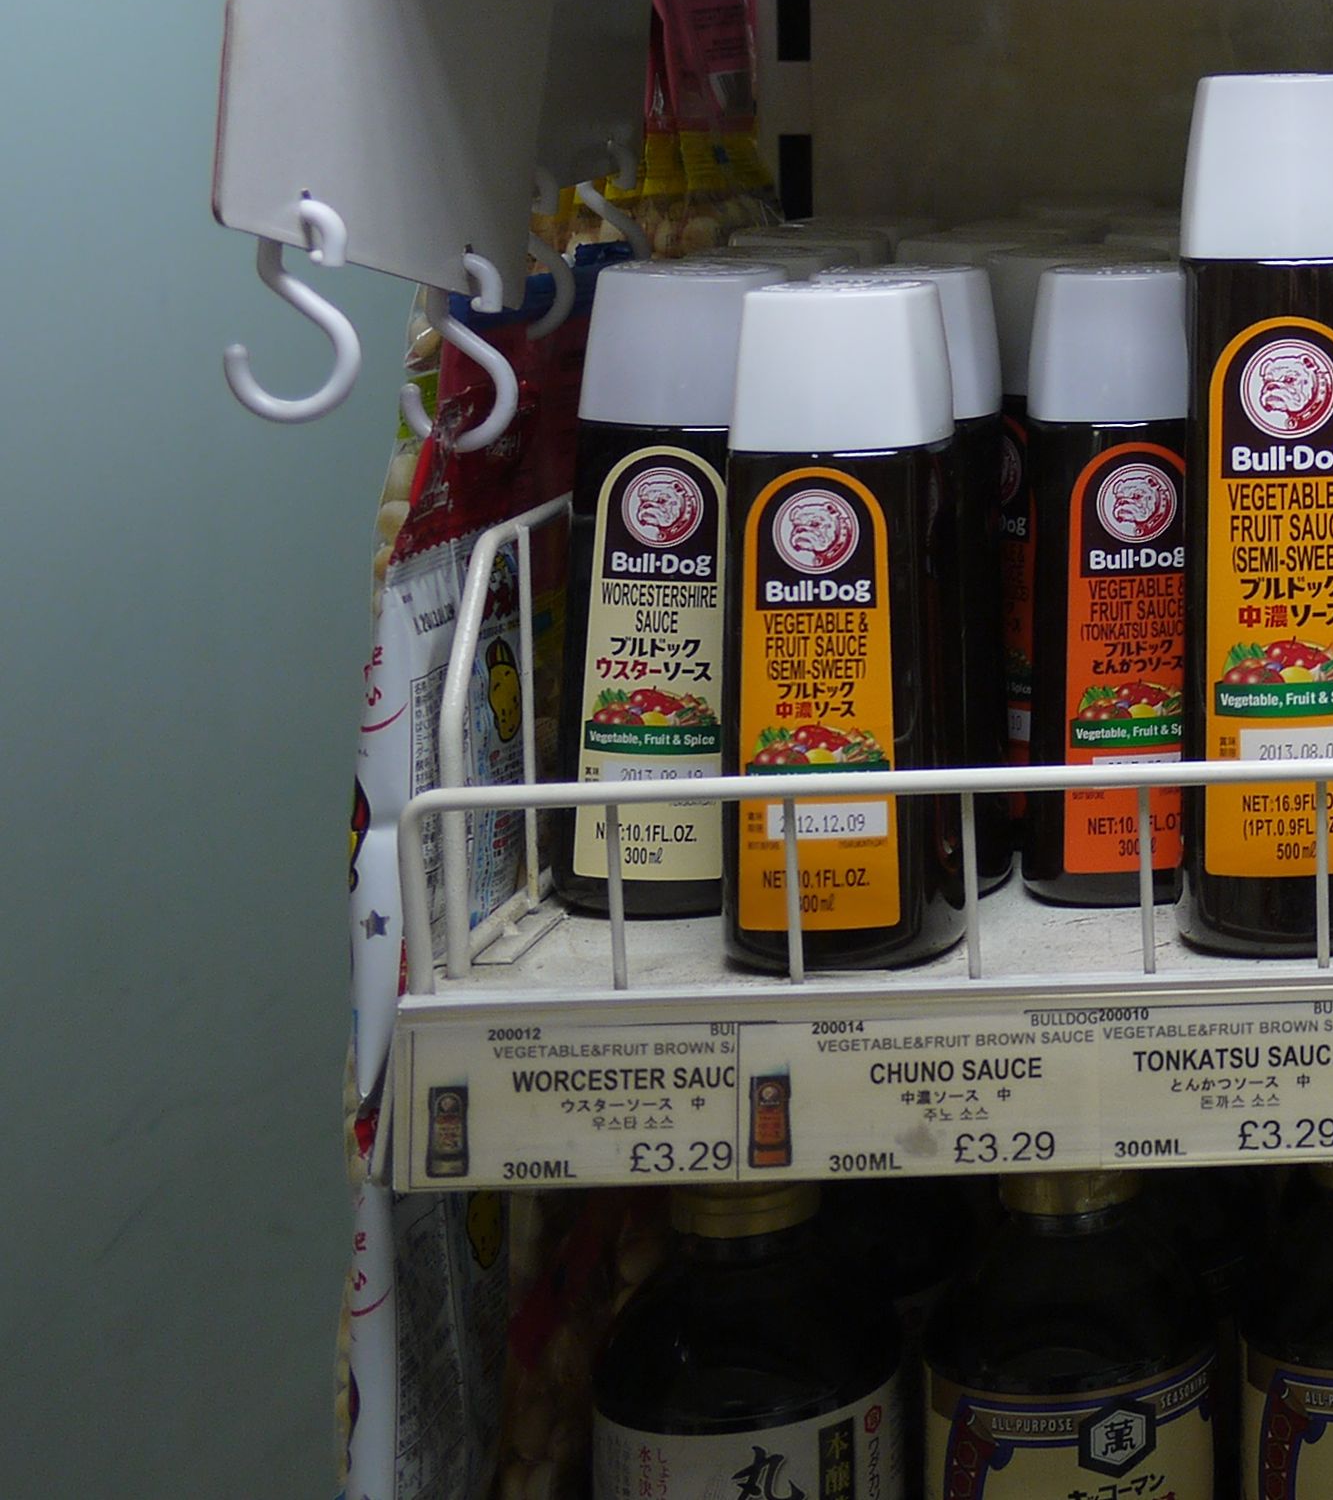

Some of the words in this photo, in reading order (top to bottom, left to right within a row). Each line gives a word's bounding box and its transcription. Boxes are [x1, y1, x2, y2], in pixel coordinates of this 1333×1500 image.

[602, 583, 717, 609] WORCESTERSHIRE
[635, 610, 678, 634] SAUCE
[596, 659, 712, 681] ウスターソース
[1031, 1012, 1098, 1027] BULLDOG
[1099, 1009, 1149, 1021] 200010
[488, 1028, 541, 1041] 200012
[871, 1062, 954, 1084] CHUNO
[962, 1058, 1042, 1080] SAUCE
[1133, 1047, 1259, 1072] TONKATSU
[513, 1067, 665, 1092] WORCESTER
[1171, 1075, 1279, 1092] とんかつソース
[954, 1131, 1055, 1163] £3.29
[503, 1161, 576, 1180] 300ML
[630, 1141, 733, 1173] £3.29
